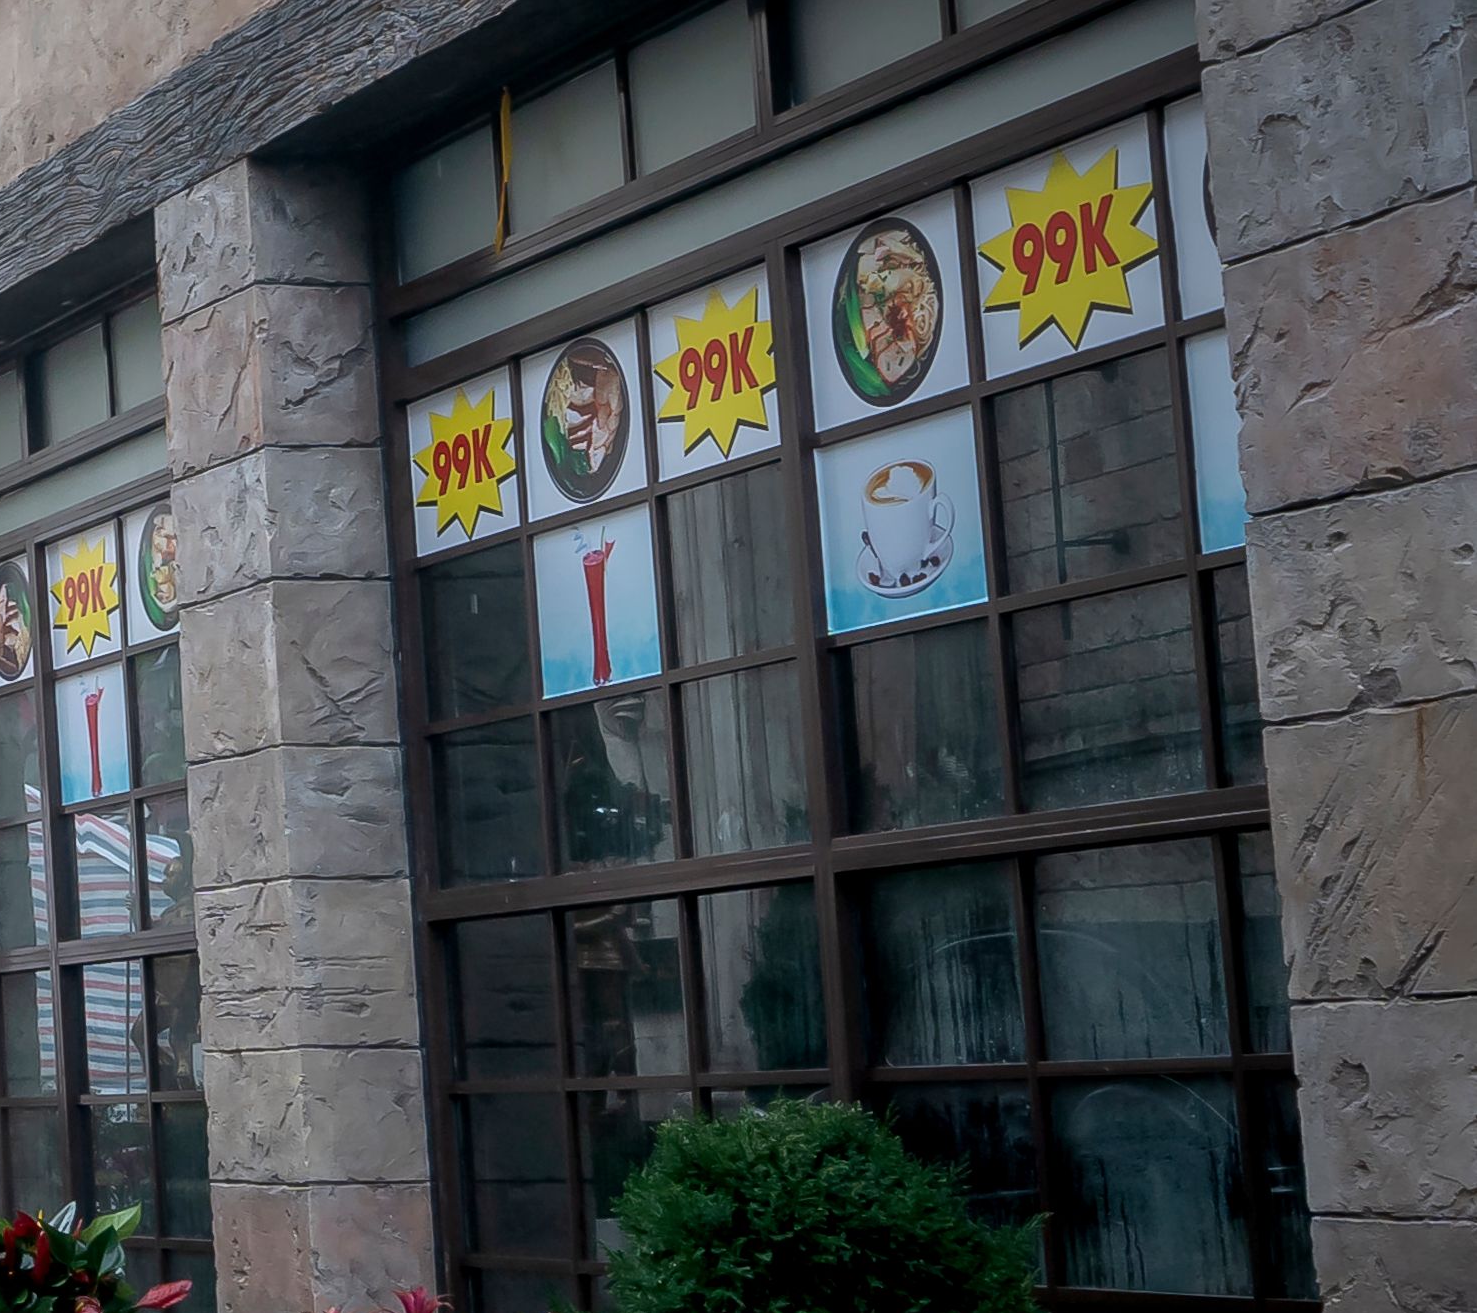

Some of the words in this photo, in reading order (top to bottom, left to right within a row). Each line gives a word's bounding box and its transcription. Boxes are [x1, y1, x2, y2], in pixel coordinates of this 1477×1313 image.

[1012, 194, 1120, 296] 99K
[678, 326, 761, 410] 99K
[432, 424, 494, 497] 99K
[64, 566, 106, 621] 99K
